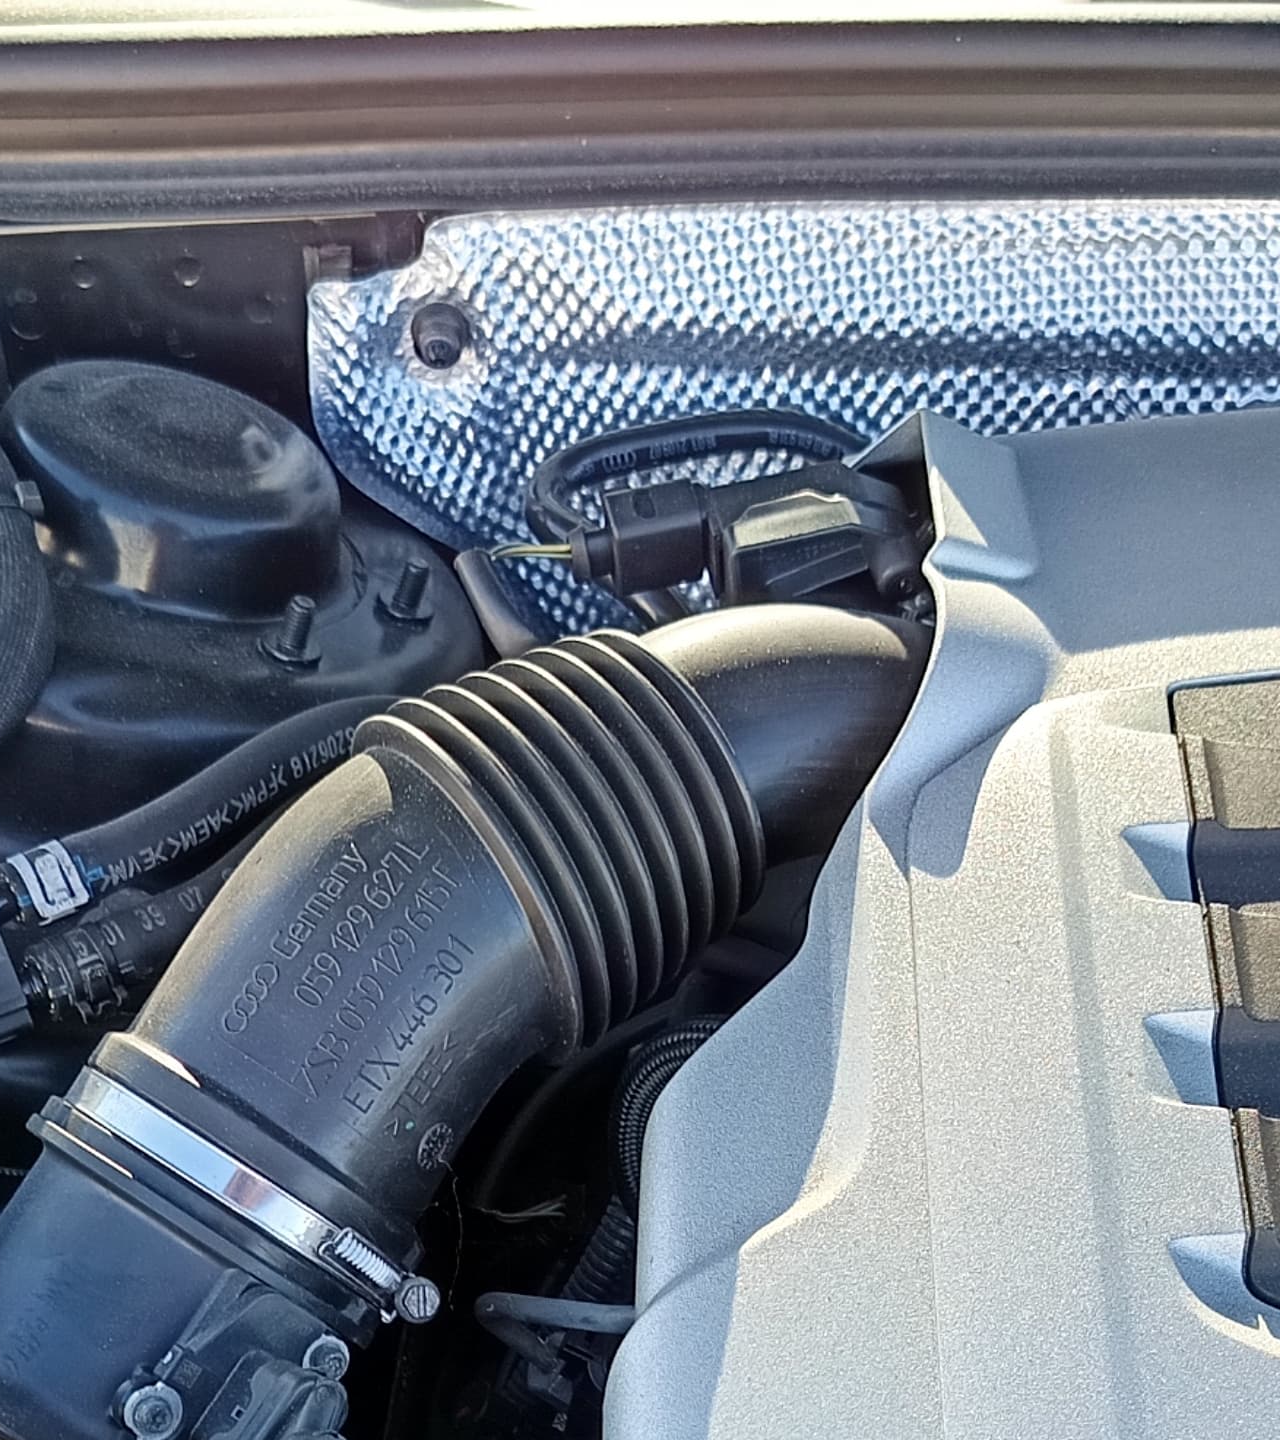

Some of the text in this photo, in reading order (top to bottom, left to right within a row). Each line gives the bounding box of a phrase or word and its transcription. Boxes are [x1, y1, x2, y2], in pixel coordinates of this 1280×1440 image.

[272, 841, 368, 960] Germany
[294, 952, 341, 1007] 059
[331, 904, 374, 952] 129
[337, 974, 384, 1031] 059
[371, 926, 415, 976] 129
[342, 933, 474, 1114] ETX 446 301
